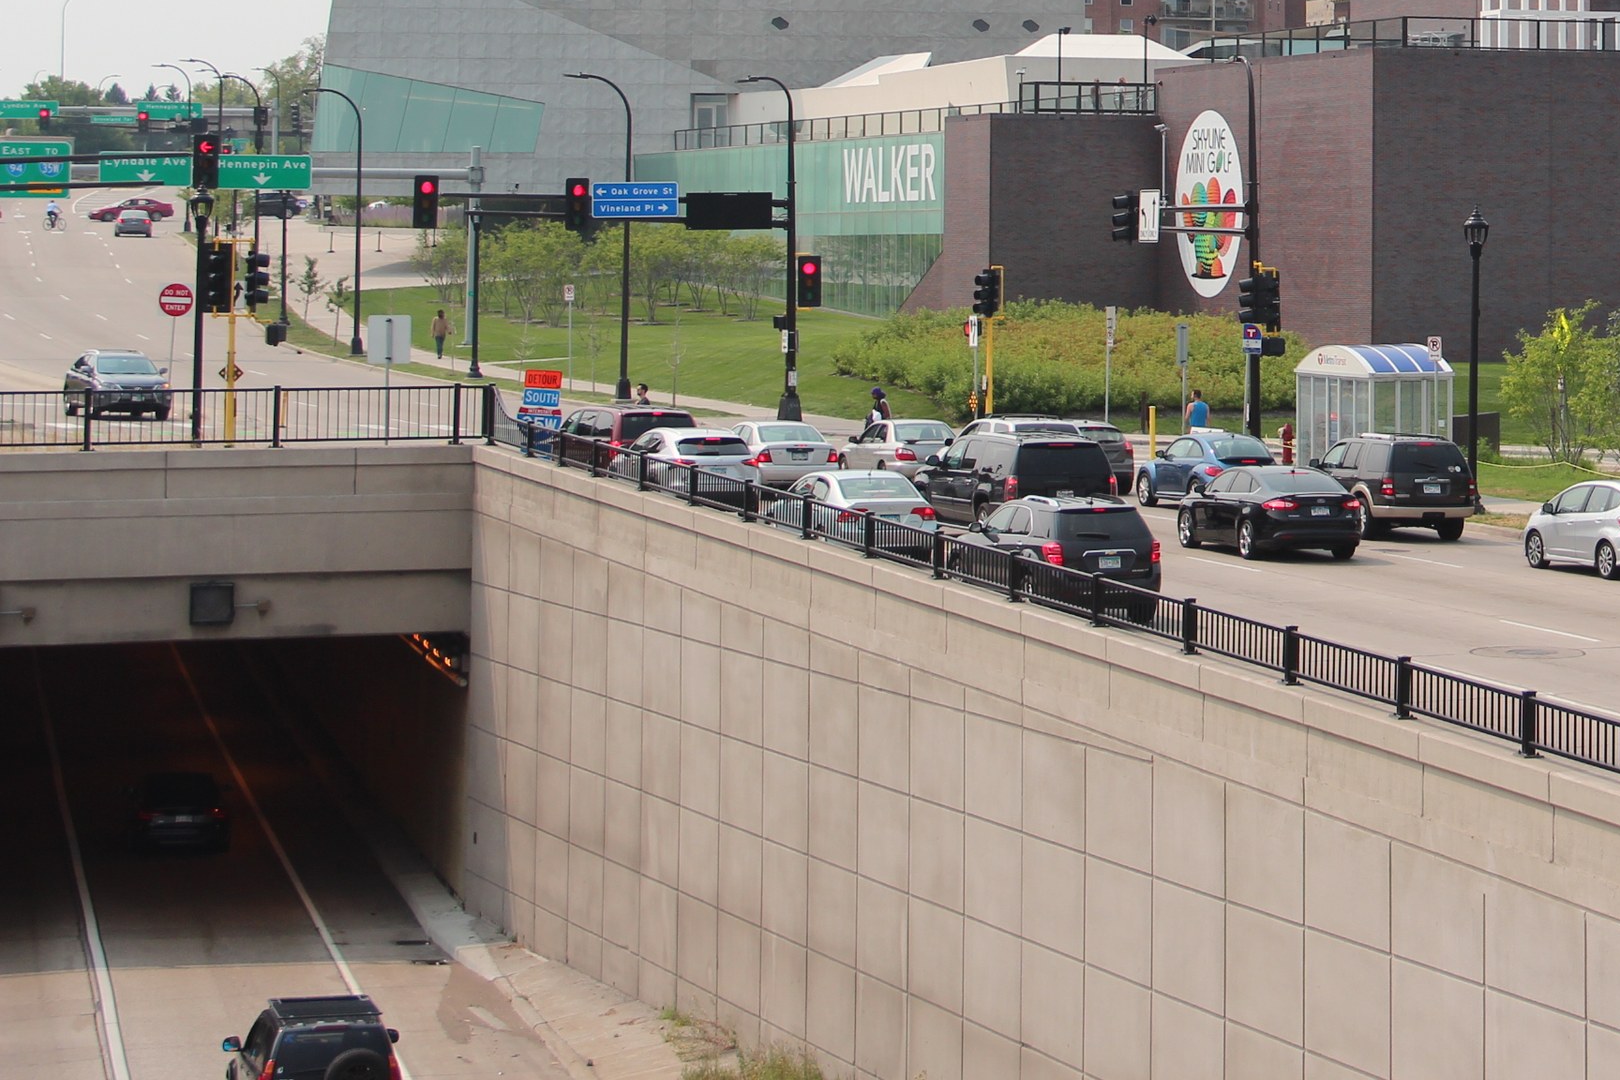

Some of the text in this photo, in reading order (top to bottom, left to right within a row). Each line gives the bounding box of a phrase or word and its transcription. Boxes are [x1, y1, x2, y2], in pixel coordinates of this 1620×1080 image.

[1192, 127, 1226, 150] SKYLINE
[2, 146, 59, 155] EAST TO
[104, 157, 187, 167] Lyndale Ave
[218, 160, 306, 170] Hennepin Ave
[1185, 150, 1232, 174] MINI GOLF
[9, 162, 60, 174] 94 35W
[843, 143, 936, 203] WALKER
[662, 187, 673, 195] St
[600, 204, 641, 212] Vineland
[528, 374, 557, 385] DETOUR
[525, 390, 558, 404] SOUTH
